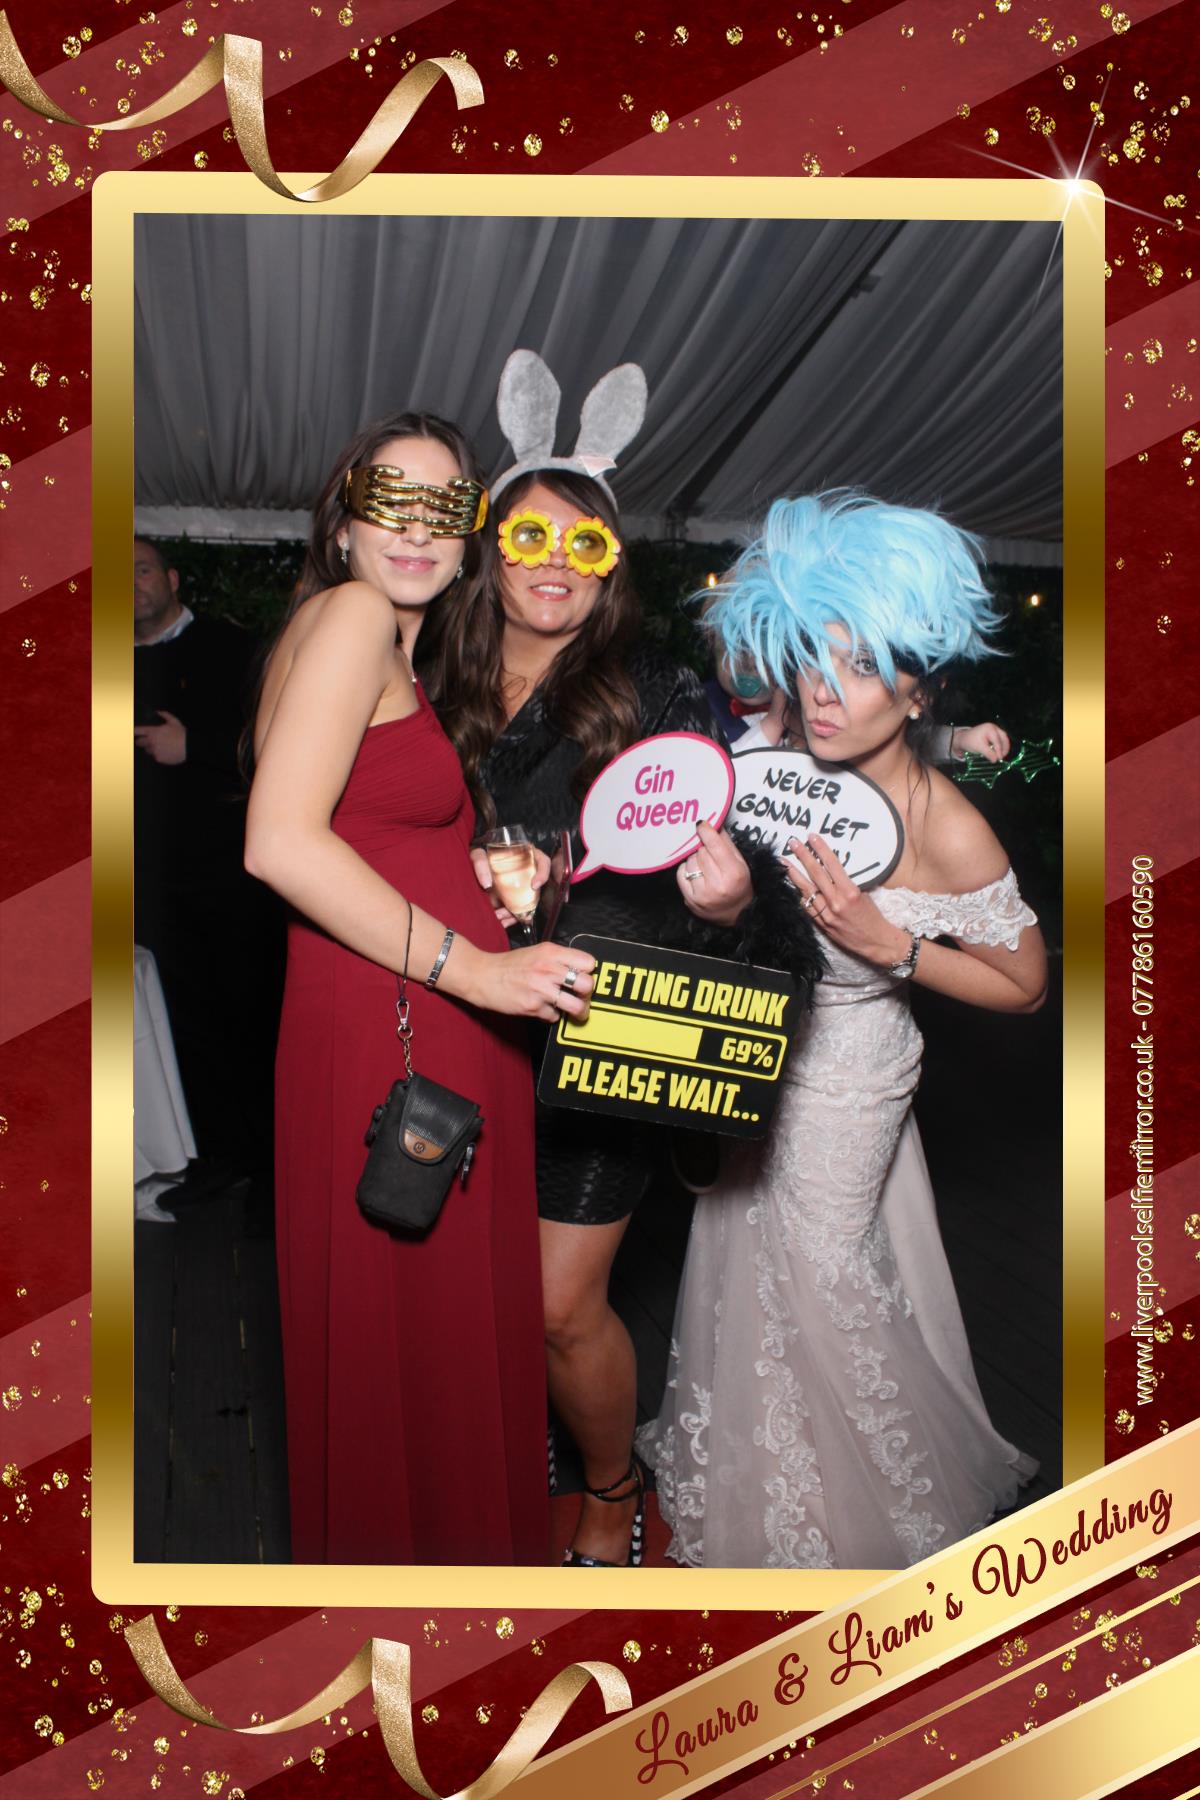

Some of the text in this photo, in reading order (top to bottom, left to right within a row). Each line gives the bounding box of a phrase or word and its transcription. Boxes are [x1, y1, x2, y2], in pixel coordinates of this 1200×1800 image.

[634, 764, 675, 796] Gin
[763, 768, 842, 805] NEVER
[616, 798, 699, 831] Queen
[736, 792, 870, 842] GONNA LET
[693, 980, 790, 1027] DRUNK
[720, 1037, 774, 1068] 69%
[557, 1056, 760, 1122] PLEASE WAIT...
